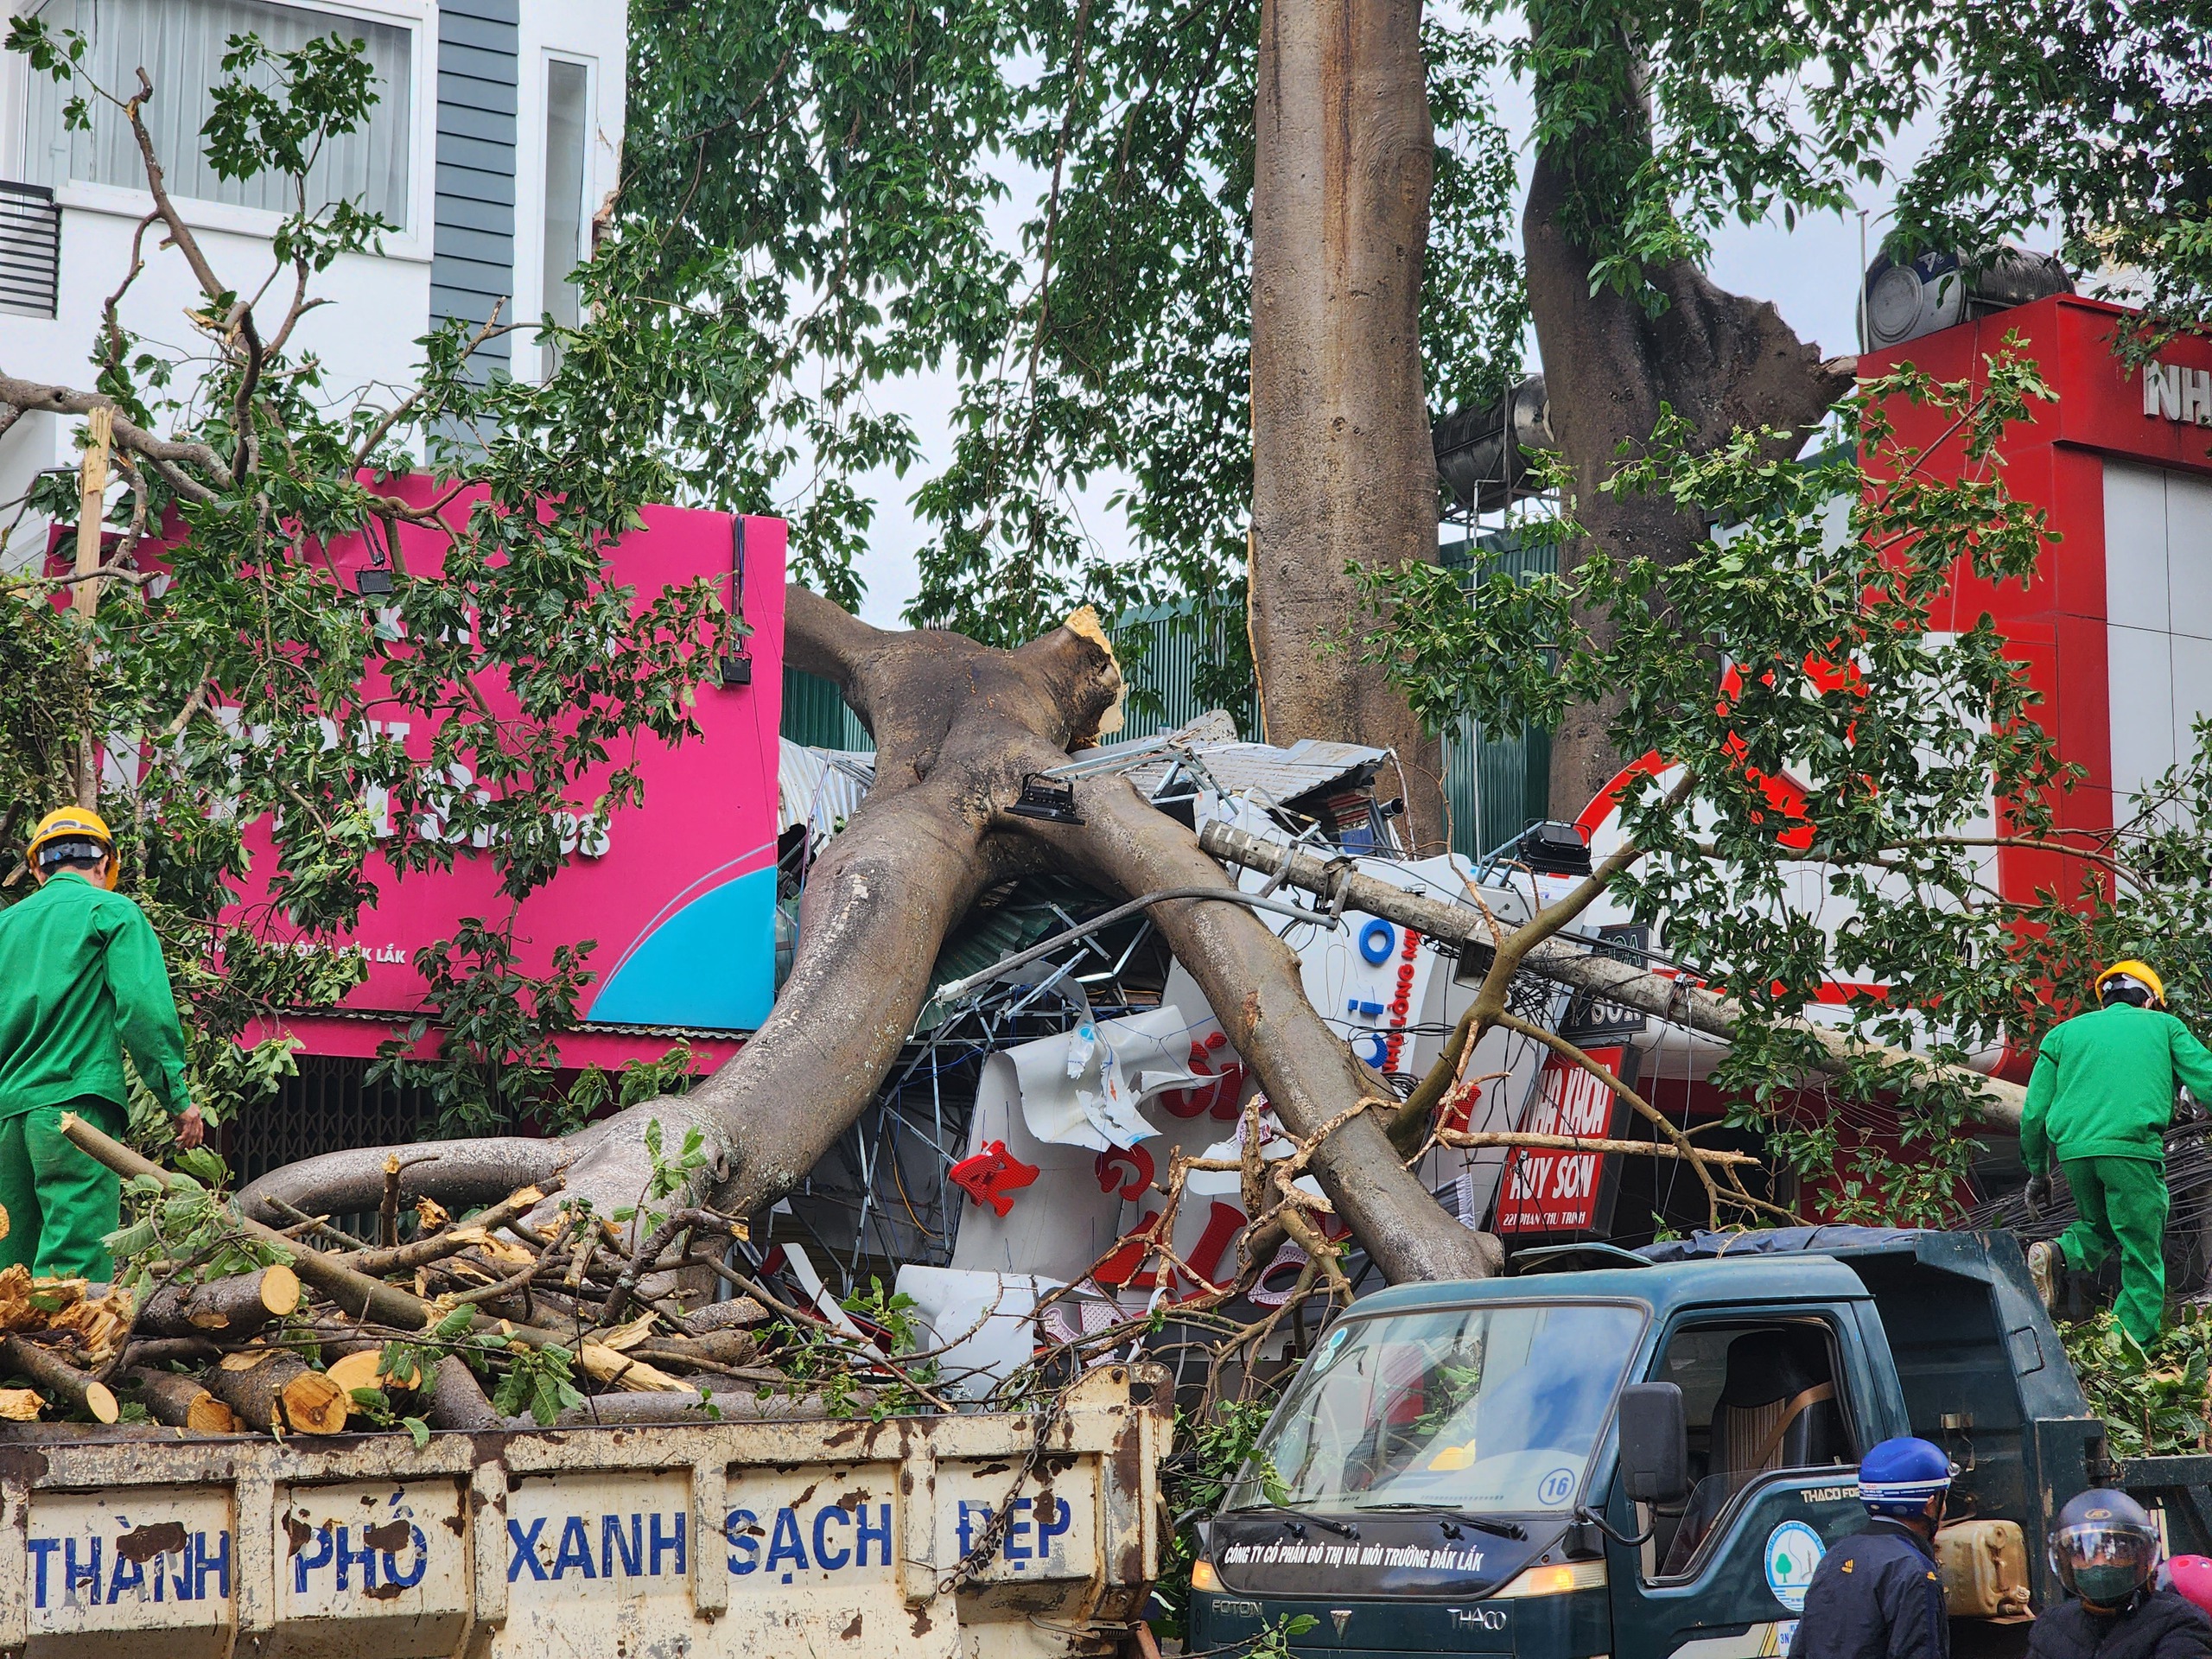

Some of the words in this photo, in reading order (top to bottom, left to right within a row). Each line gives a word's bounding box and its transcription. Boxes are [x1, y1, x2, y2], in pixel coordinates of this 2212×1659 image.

[2144, 359, 2212, 426] NH
[376, 943, 406, 964] LẮK
[1558, 1064, 1611, 1135] KHOA
[1547, 1476, 1570, 1497] 16
[1800, 1487, 1841, 1503] THACO
[28, 1515, 230, 1609] THÀNH
[295, 1491, 429, 1599] PHỐ
[506, 1511, 686, 1583] XANH
[726, 1503, 892, 1585] SẠCH
[954, 1497, 1071, 1571] ĐẸP
[1224, 1541, 1251, 1565] CÔNG
[1251, 1544, 1266, 1564] TY
[1262, 1536, 1284, 1564] CỔ
[1278, 1538, 1306, 1565] PHẦN
[1306, 1541, 1325, 1565] ĐÔ
[1324, 1544, 1344, 1569] THỊ
[1343, 1541, 1361, 1566] VÀ
[1359, 1542, 1384, 1566] MÔI
[1383, 1543, 1431, 1568] TRƯỜNG
[1429, 1542, 1458, 1570] ĐẮK
[1456, 1544, 1484, 1572] LẮK
[1211, 1599, 1264, 1619] FOTON
[1446, 1607, 1508, 1631] THACO
